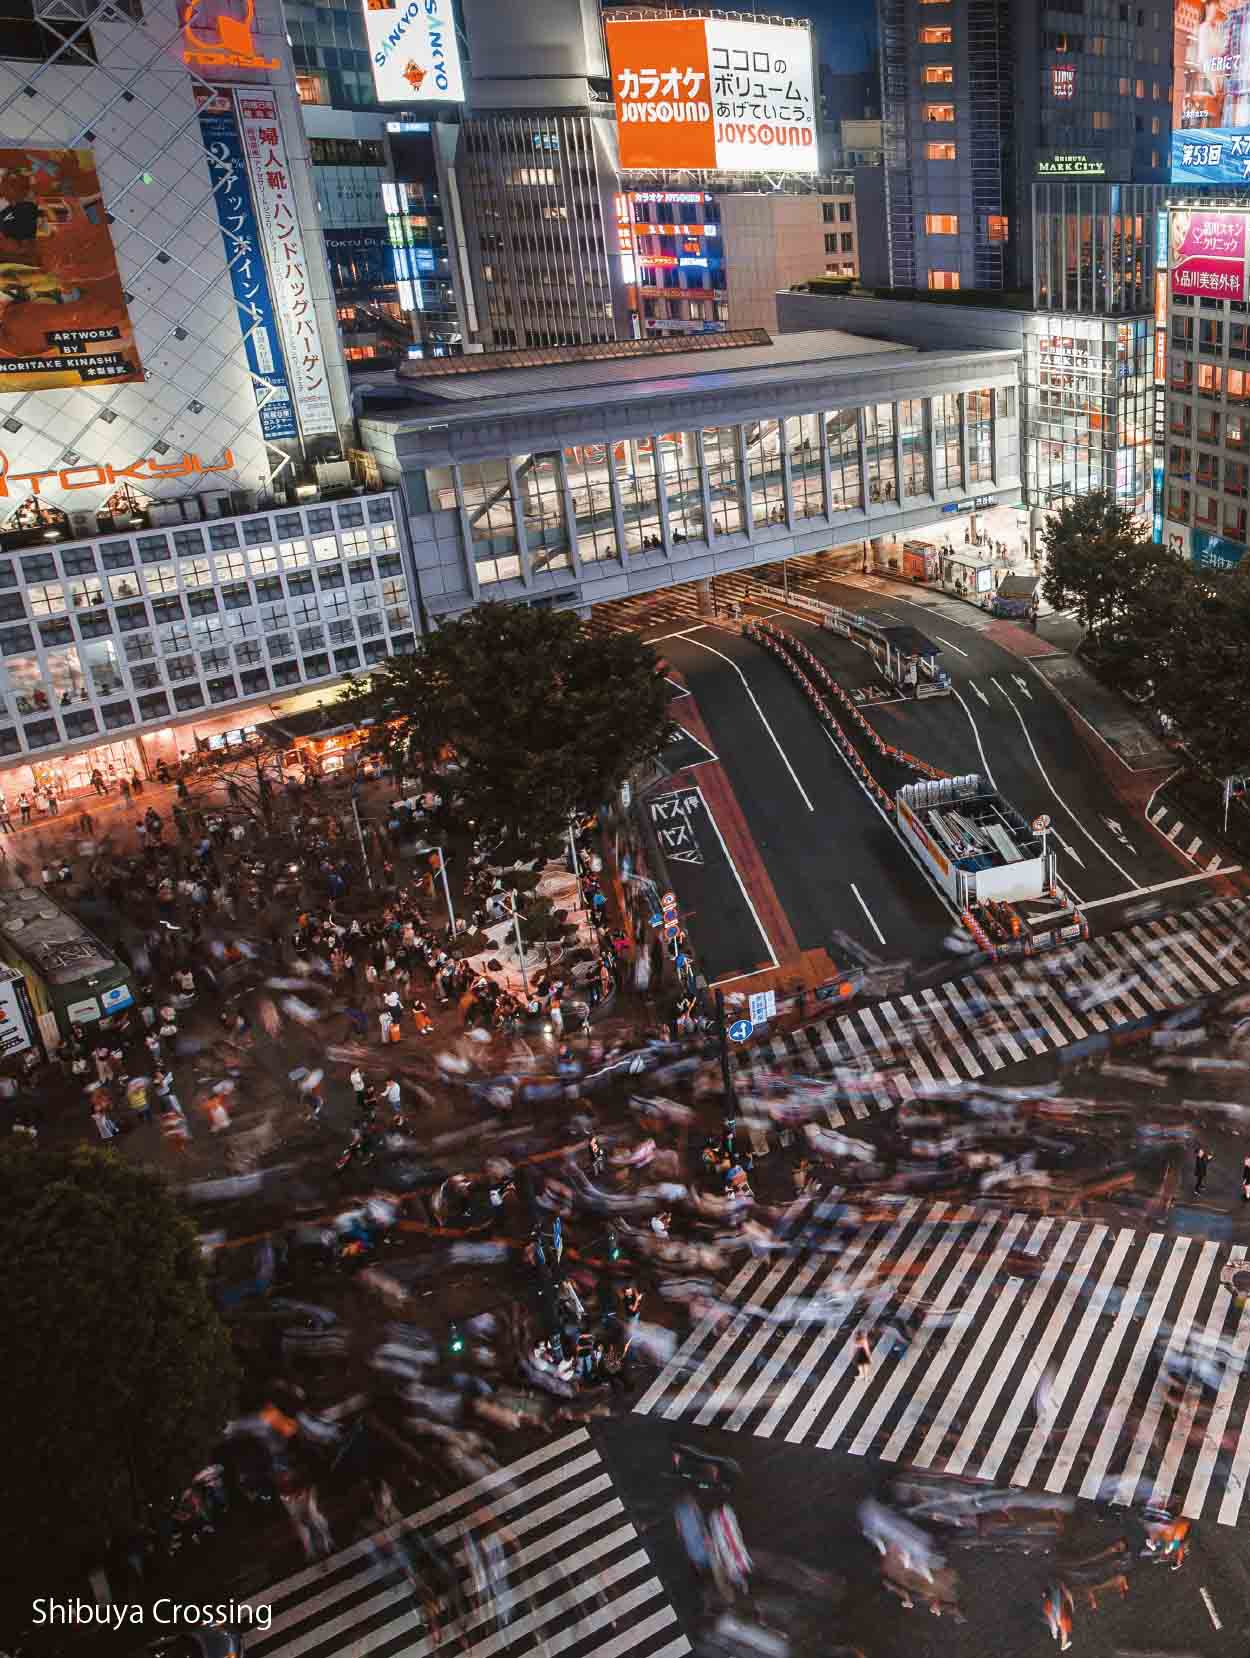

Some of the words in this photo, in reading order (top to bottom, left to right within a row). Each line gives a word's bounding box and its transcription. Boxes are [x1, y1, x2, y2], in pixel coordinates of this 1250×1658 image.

[374, 3, 418, 67] SANKYO
[712, 47, 787, 74] ココロの
[618, 67, 705, 99] カラオケ
[714, 73, 809, 102] ボリューム、
[621, 102, 710, 123] JOYSOUND
[716, 102, 812, 122] あげていこう。
[717, 122, 813, 146] JOYSOUND
[1182, 144, 1222, 166] 第53回
[1180, 270, 1241, 293] 品川美容外科
[54, 329, 114, 341] ARTWORK
[63, 345, 78, 354] BY
[0, 360, 62, 371] NORITAKE
[67, 355, 117, 367] KINASHI
[7, 447, 235, 495] TOKYU
